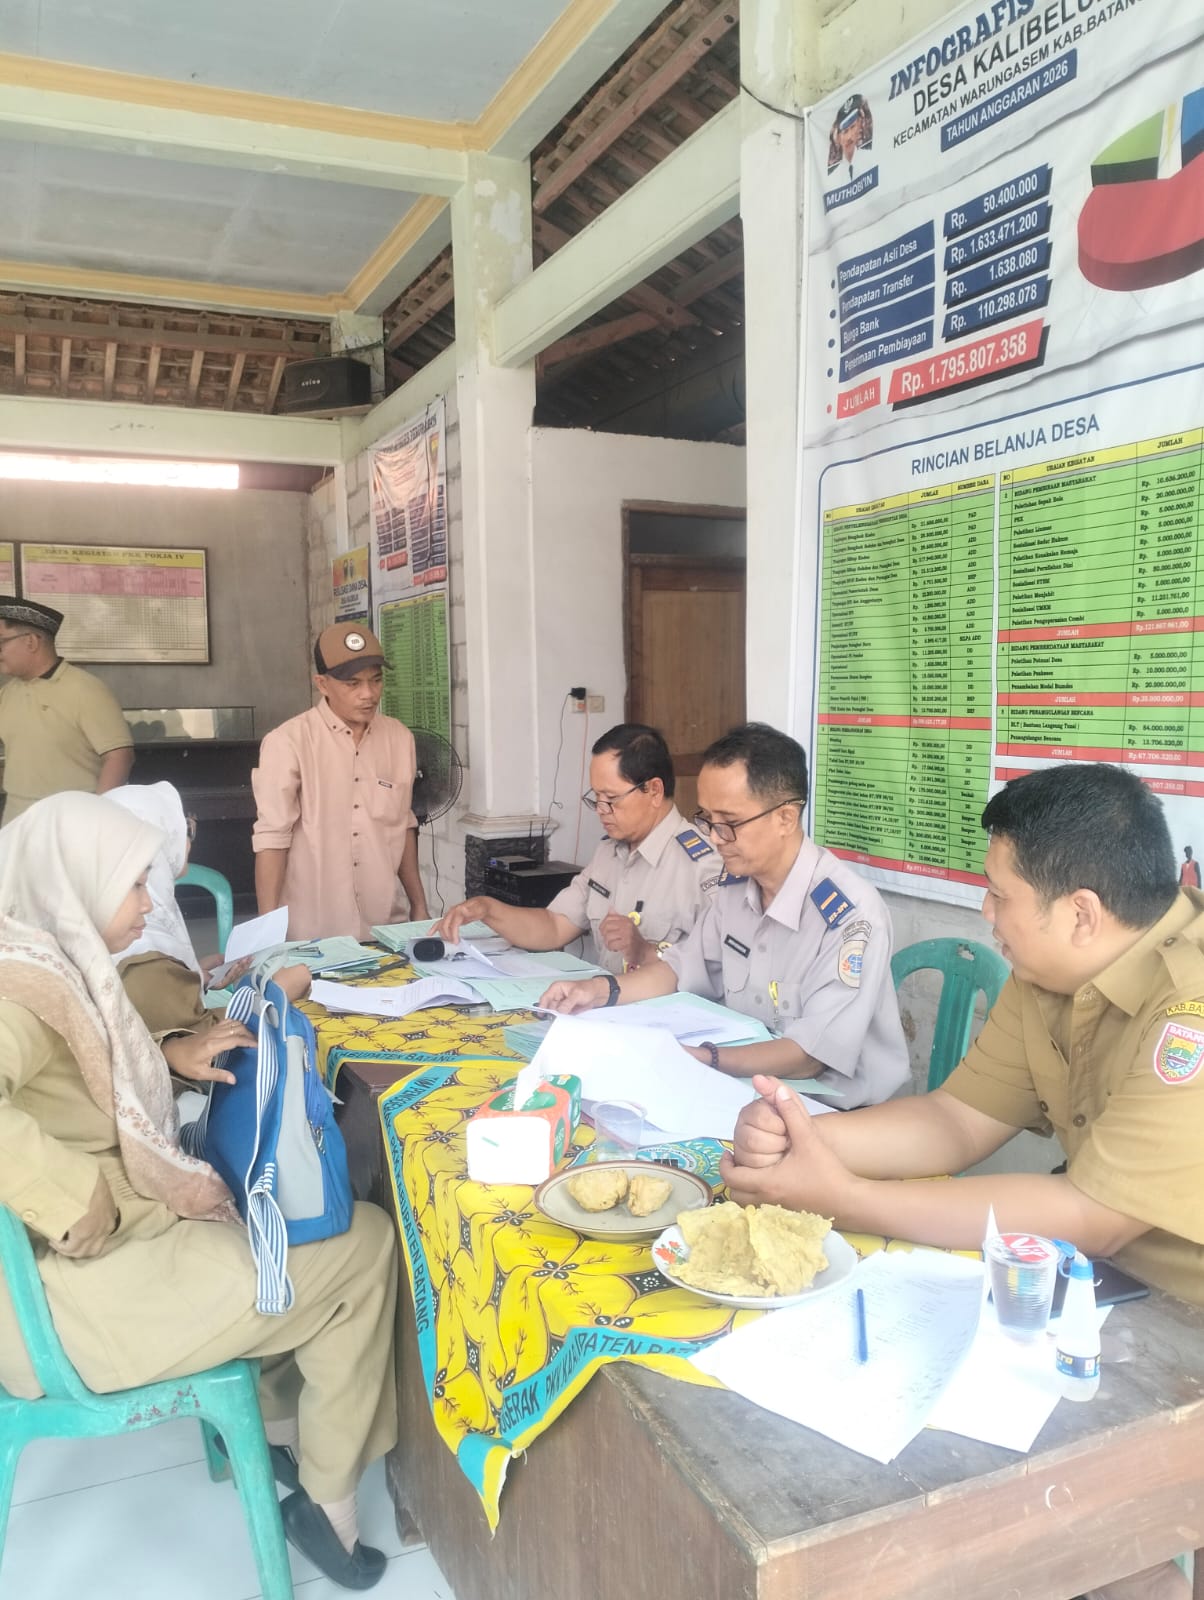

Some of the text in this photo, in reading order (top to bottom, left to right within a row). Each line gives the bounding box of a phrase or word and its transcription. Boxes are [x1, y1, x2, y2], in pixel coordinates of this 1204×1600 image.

[888, 0, 1036, 101] INFOGRAFIS
[893, 0, 1141, 148] KECAMATAN WARUNGASEM KAB.BATAN
[913, 0, 1101, 116] DESA KALIBEL
[946, 60, 1069, 142] TAHUN ANGGARAN 2026
[951, 173, 1038, 230] Rp. 50.400.000
[839, 239, 918, 283] Pendapatan Asli Desa
[951, 211, 1038, 264] Rp. 1.633.471.200
[882, 274, 914, 298] Transfer
[951, 247, 1038, 298] Rp. 1.638.080
[860, 318, 880, 335] Bank
[950, 283, 1037, 332] Rp. 110.298.078
[878, 331, 927, 359] Pembiayaan
[901, 368, 924, 397] Rp.
[928, 331, 1028, 386] 1.795.807.358
[911, 414, 1100, 476] RINCIAN BELANJA DESA
[1157, 437, 1183, 449] JUMLAH
[413, 1266, 430, 1335] BATANG
